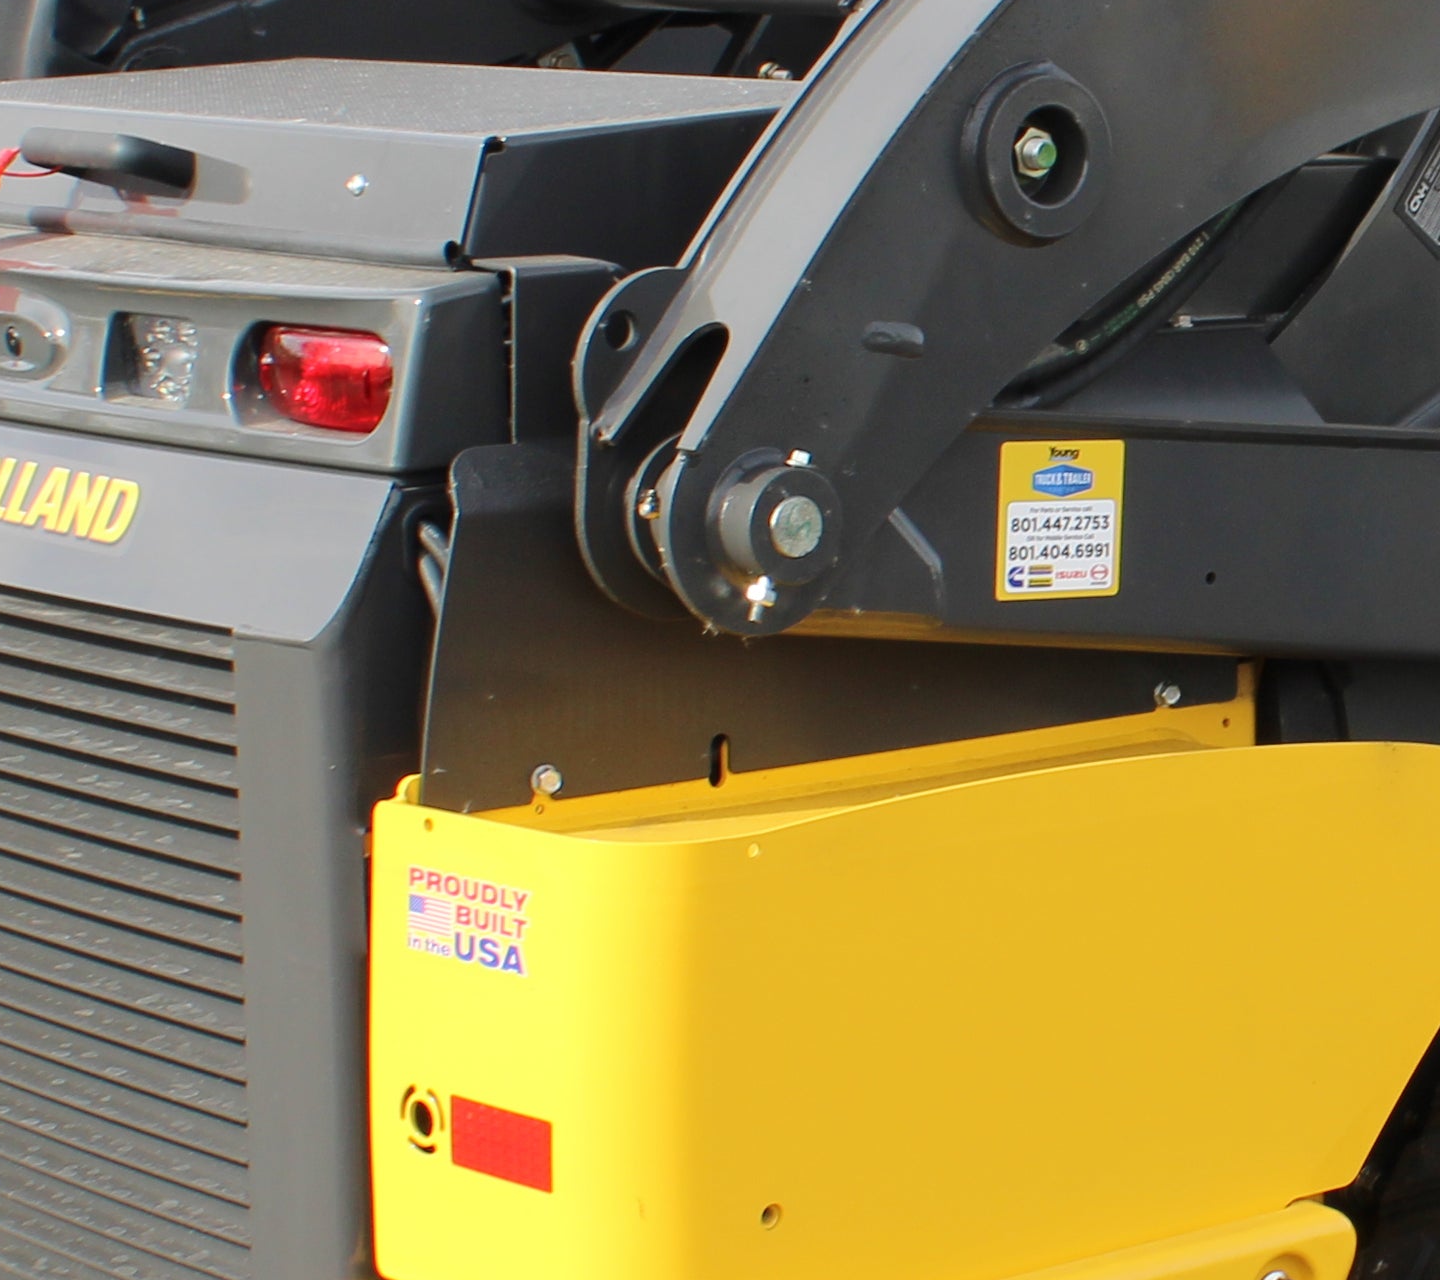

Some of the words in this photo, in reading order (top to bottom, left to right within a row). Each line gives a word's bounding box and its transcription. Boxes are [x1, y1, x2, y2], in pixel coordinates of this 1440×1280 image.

[1049, 447, 1080, 461] Young
[1063, 472, 1091, 485] TRAILER
[1011, 515, 1110, 532] 801.447.2753
[1009, 543, 1109, 561] 801.404.6991
[1055, 571, 1088, 579] ISUZU
[409, 867, 528, 912] PROUDLY
[455, 904, 528, 940] BUILT
[407, 934, 422, 951] in
[424, 938, 451, 957] the
[454, 932, 525, 975] USA
